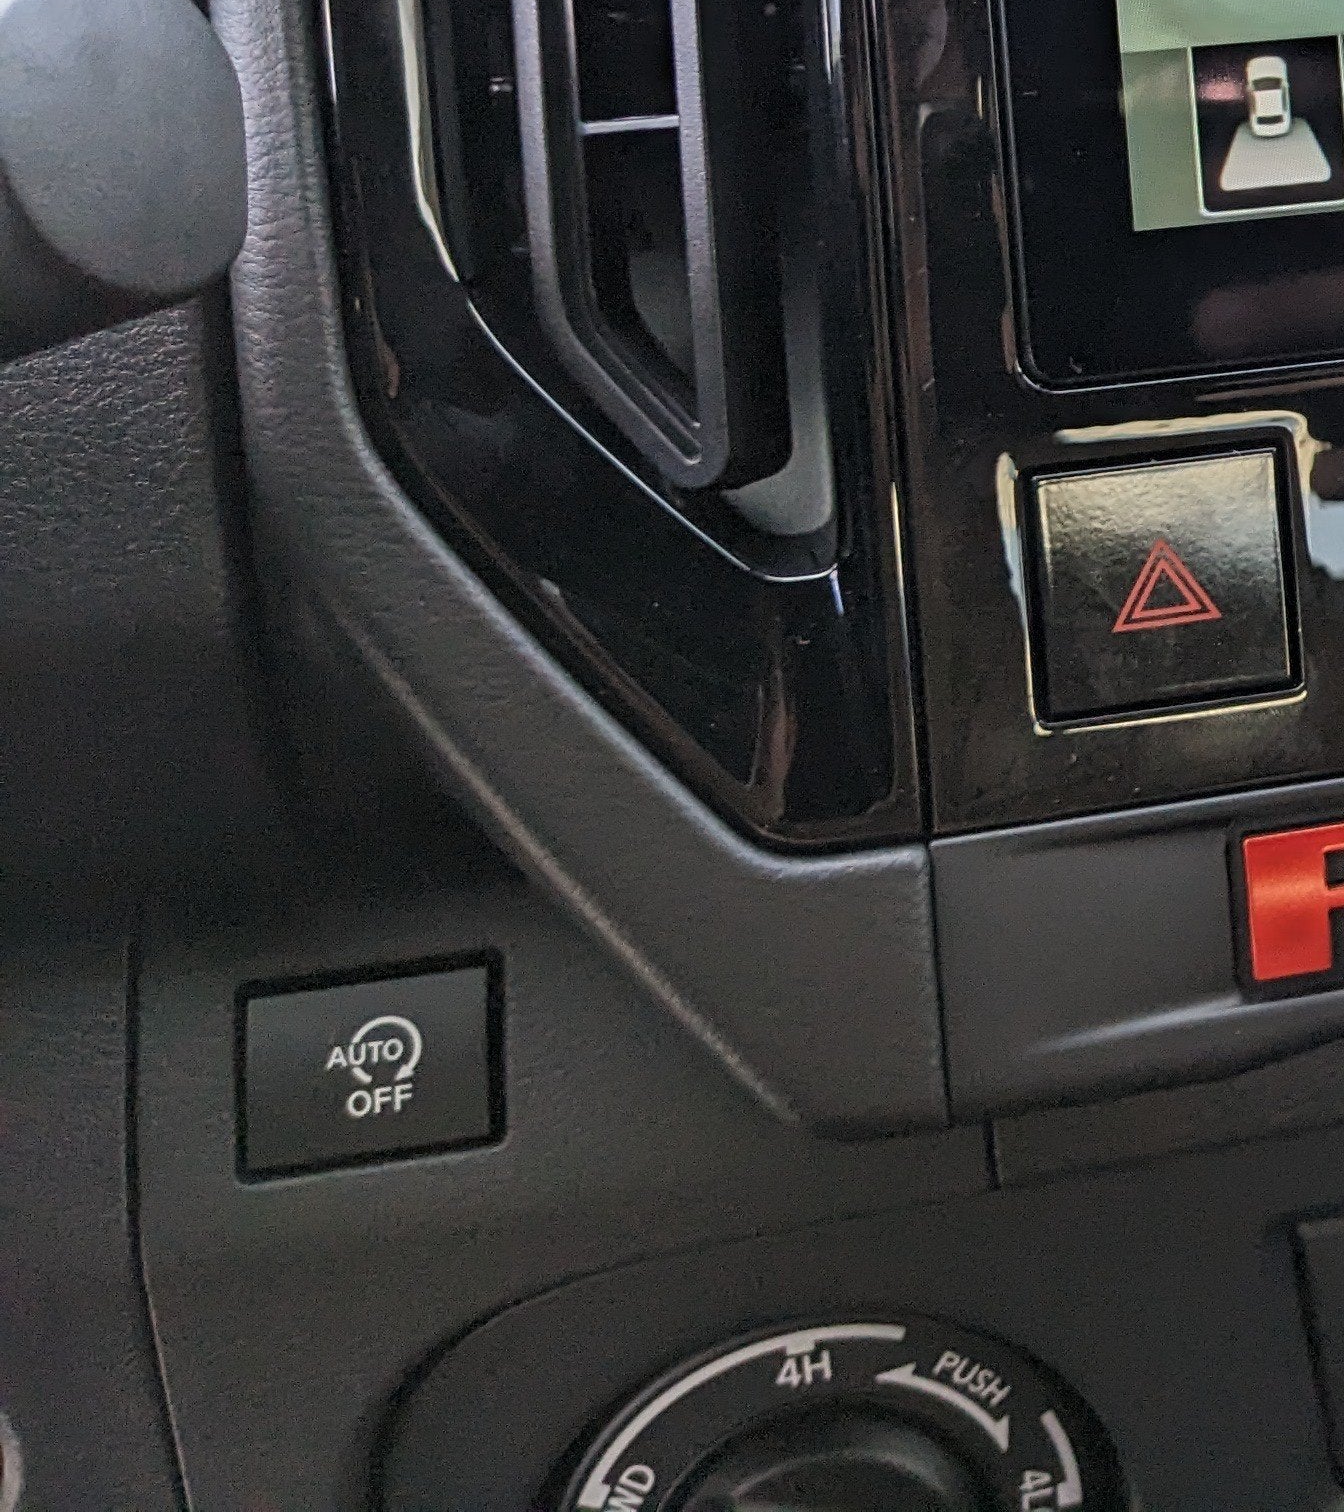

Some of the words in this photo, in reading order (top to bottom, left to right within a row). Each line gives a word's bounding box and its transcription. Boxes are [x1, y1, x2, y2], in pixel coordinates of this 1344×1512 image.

[325, 1038, 404, 1071] AUTO
[347, 1083, 413, 1117] OFF
[776, 1349, 833, 1388] 4H
[932, 1350, 1010, 1407] PUSH
